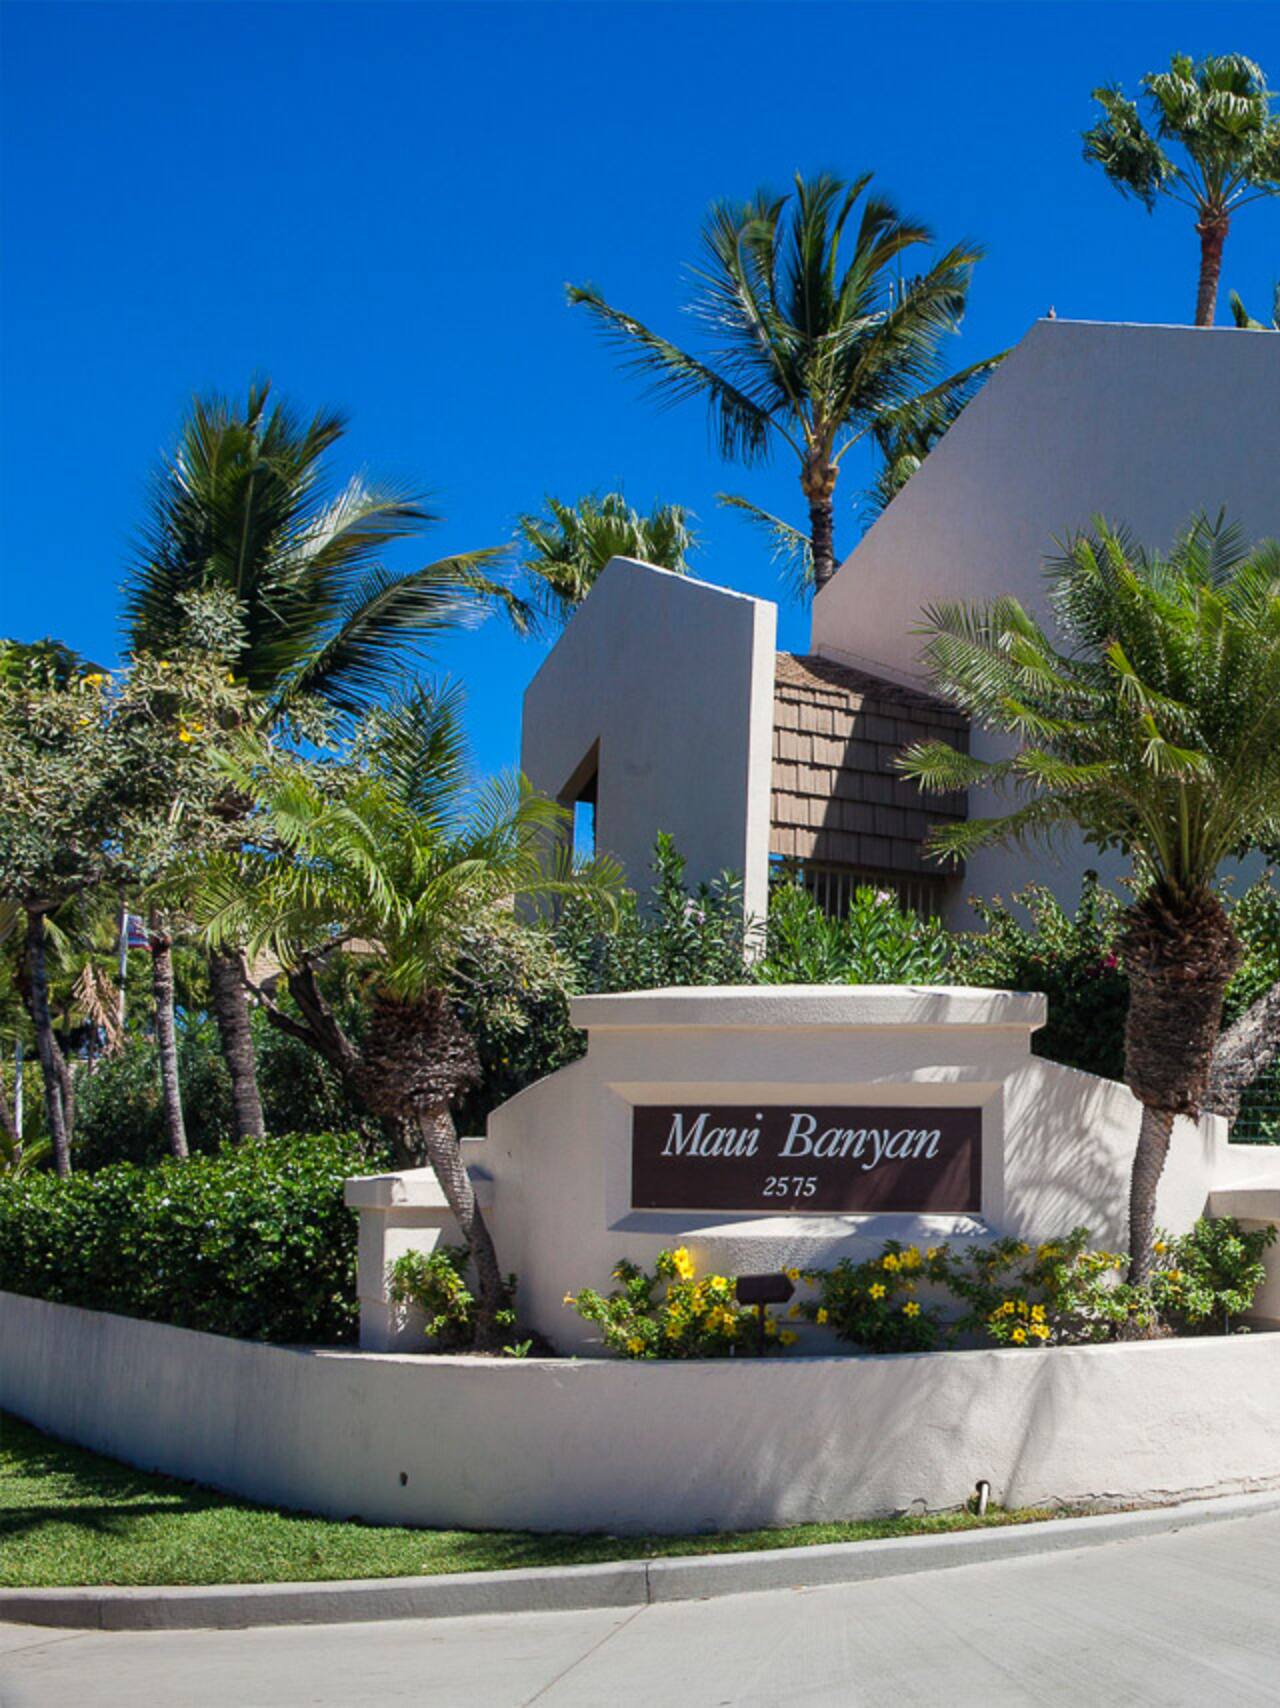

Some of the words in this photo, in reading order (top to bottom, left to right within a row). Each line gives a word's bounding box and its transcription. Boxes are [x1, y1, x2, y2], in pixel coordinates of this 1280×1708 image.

[661, 1112, 763, 1157] Maui
[778, 1112, 941, 1170] Banyan
[762, 1176, 817, 1197] 2575
